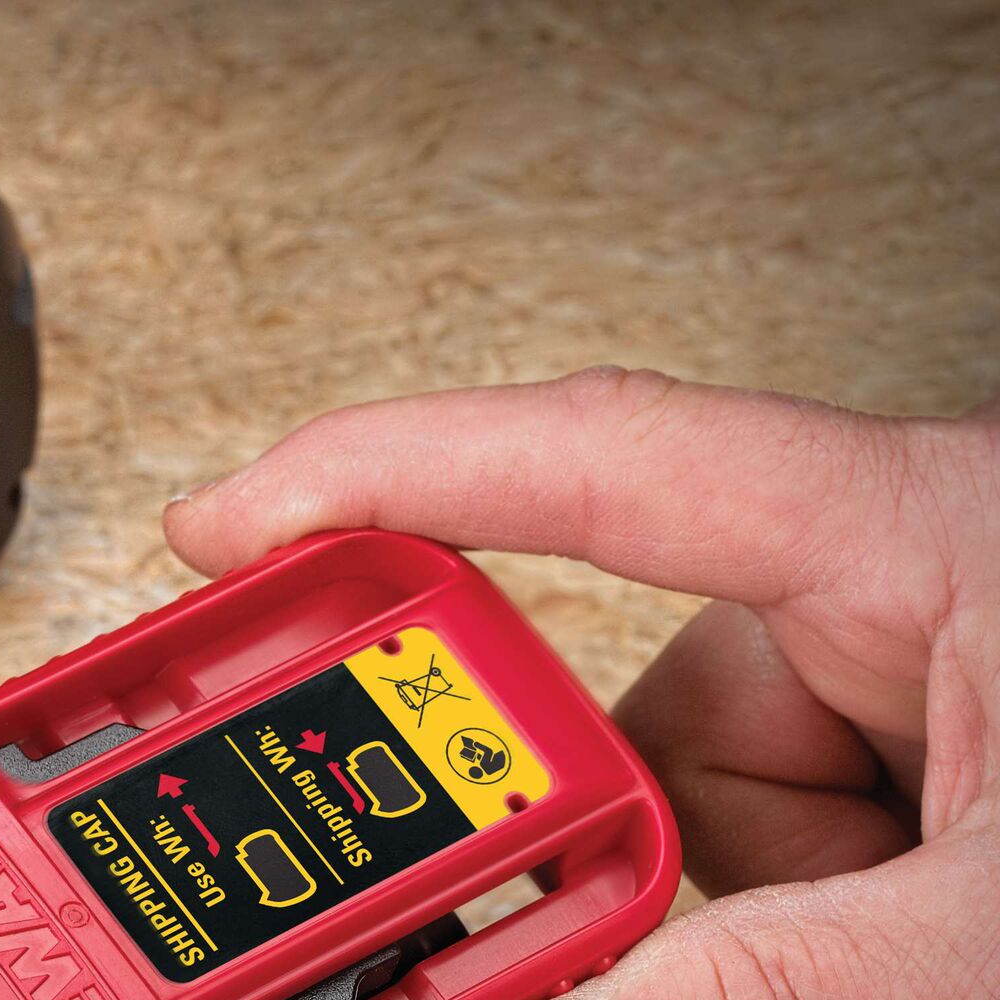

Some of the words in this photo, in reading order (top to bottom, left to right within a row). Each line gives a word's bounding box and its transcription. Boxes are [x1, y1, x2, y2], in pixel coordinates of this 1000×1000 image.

[254, 725, 297, 775] Wh:
[69, 810, 120, 857] CAP
[149, 814, 192, 864] Wh:
[291, 769, 373, 869] Shipping
[186, 861, 226, 908] Use
[108, 855, 206, 967] SHIPPING
